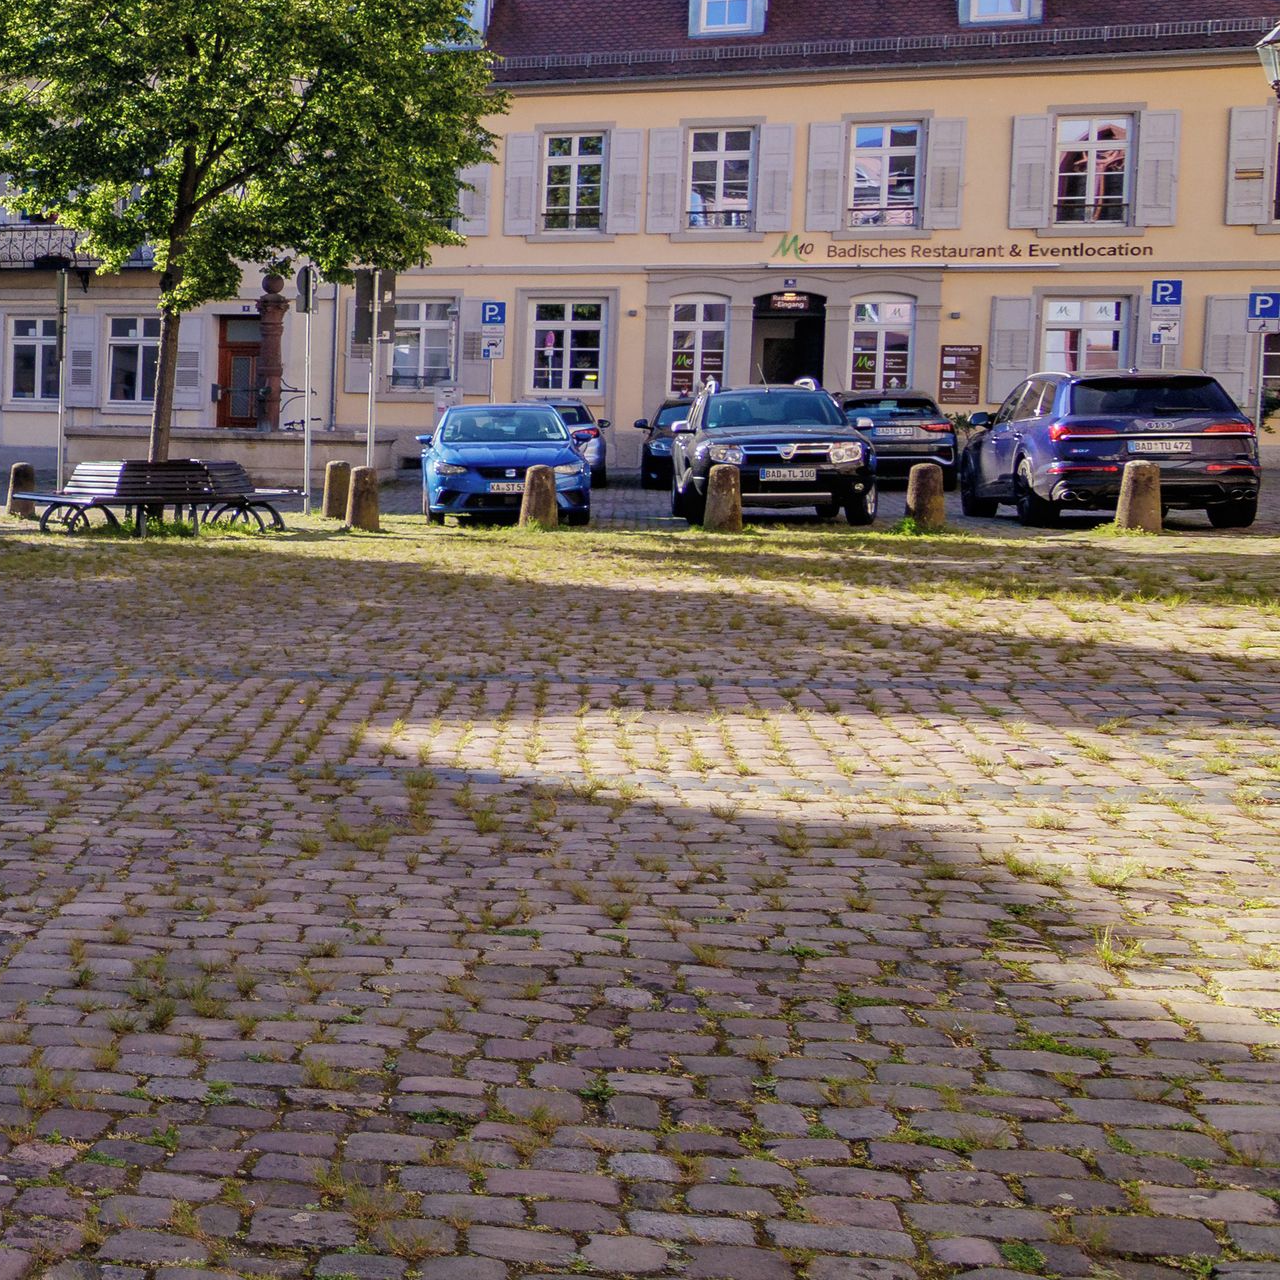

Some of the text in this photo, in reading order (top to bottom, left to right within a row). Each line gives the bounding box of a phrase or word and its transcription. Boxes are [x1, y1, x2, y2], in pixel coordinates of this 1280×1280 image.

[827, 244, 906, 258] Badisches
[911, 244, 1004, 258] Restaurant
[1009, 244, 1022, 257] &
[1029, 242, 1153, 257] Eventlocation
[1156, 283, 1173, 302] P
[485, 304, 499, 322] P
[1255, 295, 1273, 315] P
[1135, 441, 1191, 451] BAD TU 472
[765, 469, 815, 478] BAD TL 100
[505, 483, 515, 492] ST
